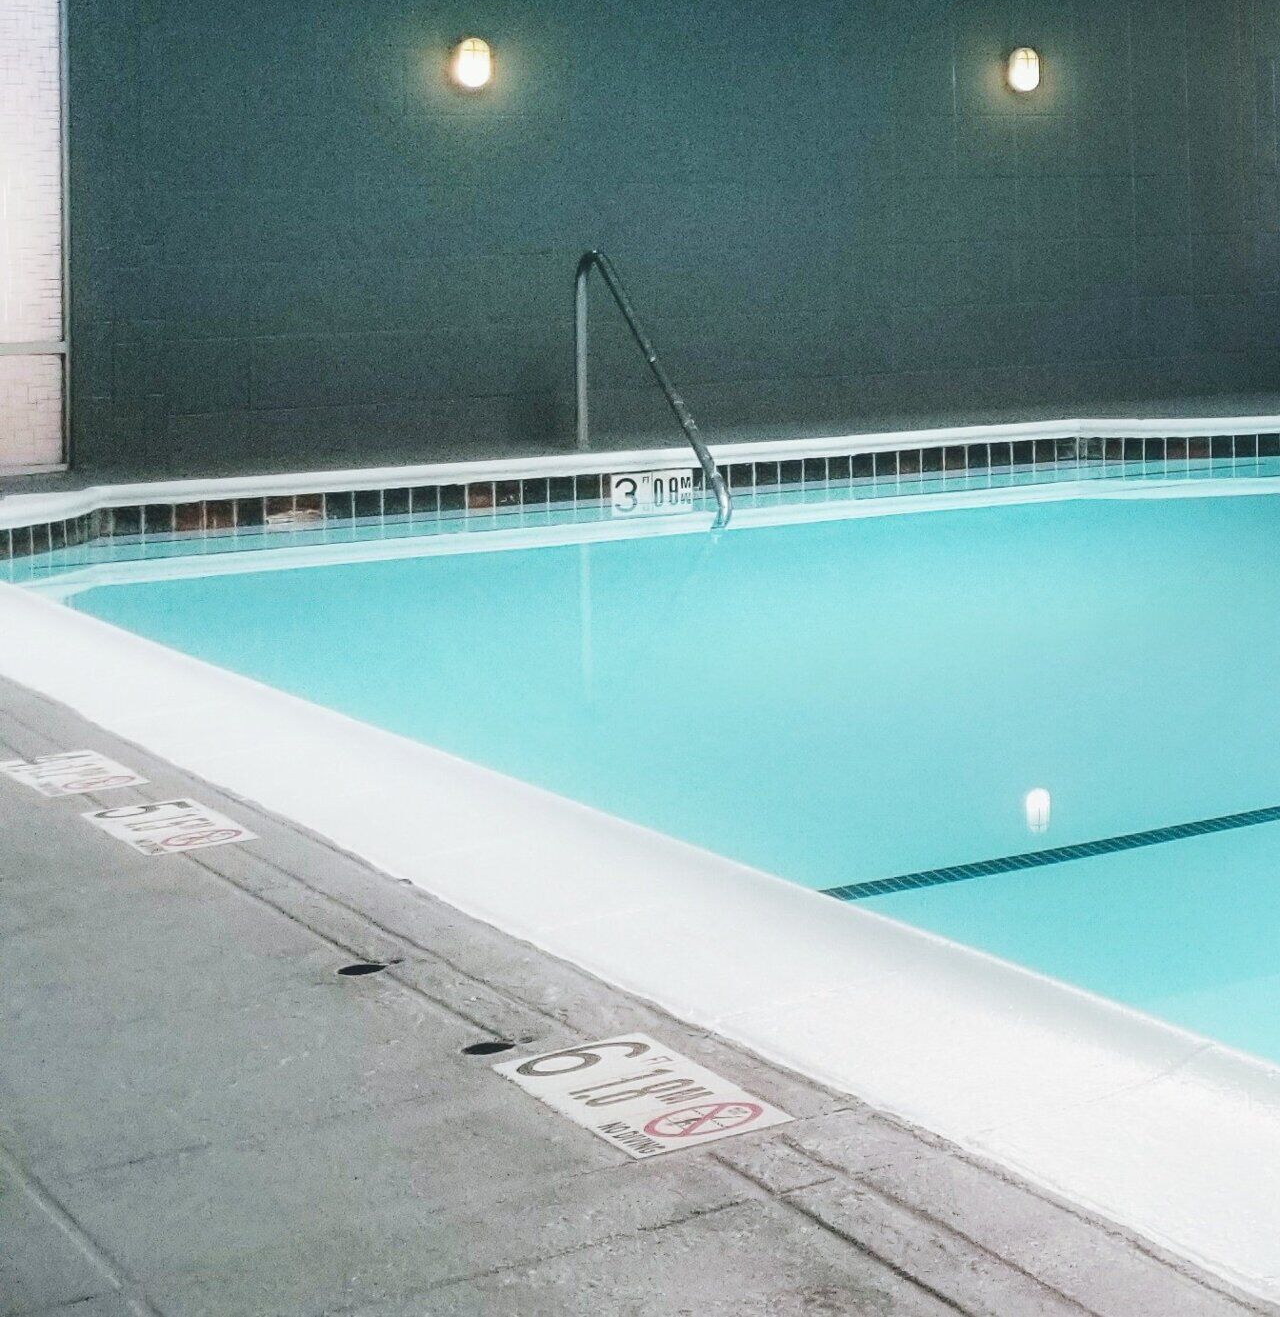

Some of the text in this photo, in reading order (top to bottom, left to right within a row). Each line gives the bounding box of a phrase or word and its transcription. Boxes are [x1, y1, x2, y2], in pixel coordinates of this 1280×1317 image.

[516, 1041, 651, 1077] 6
[596, 1121, 666, 1154] NO DIVING
